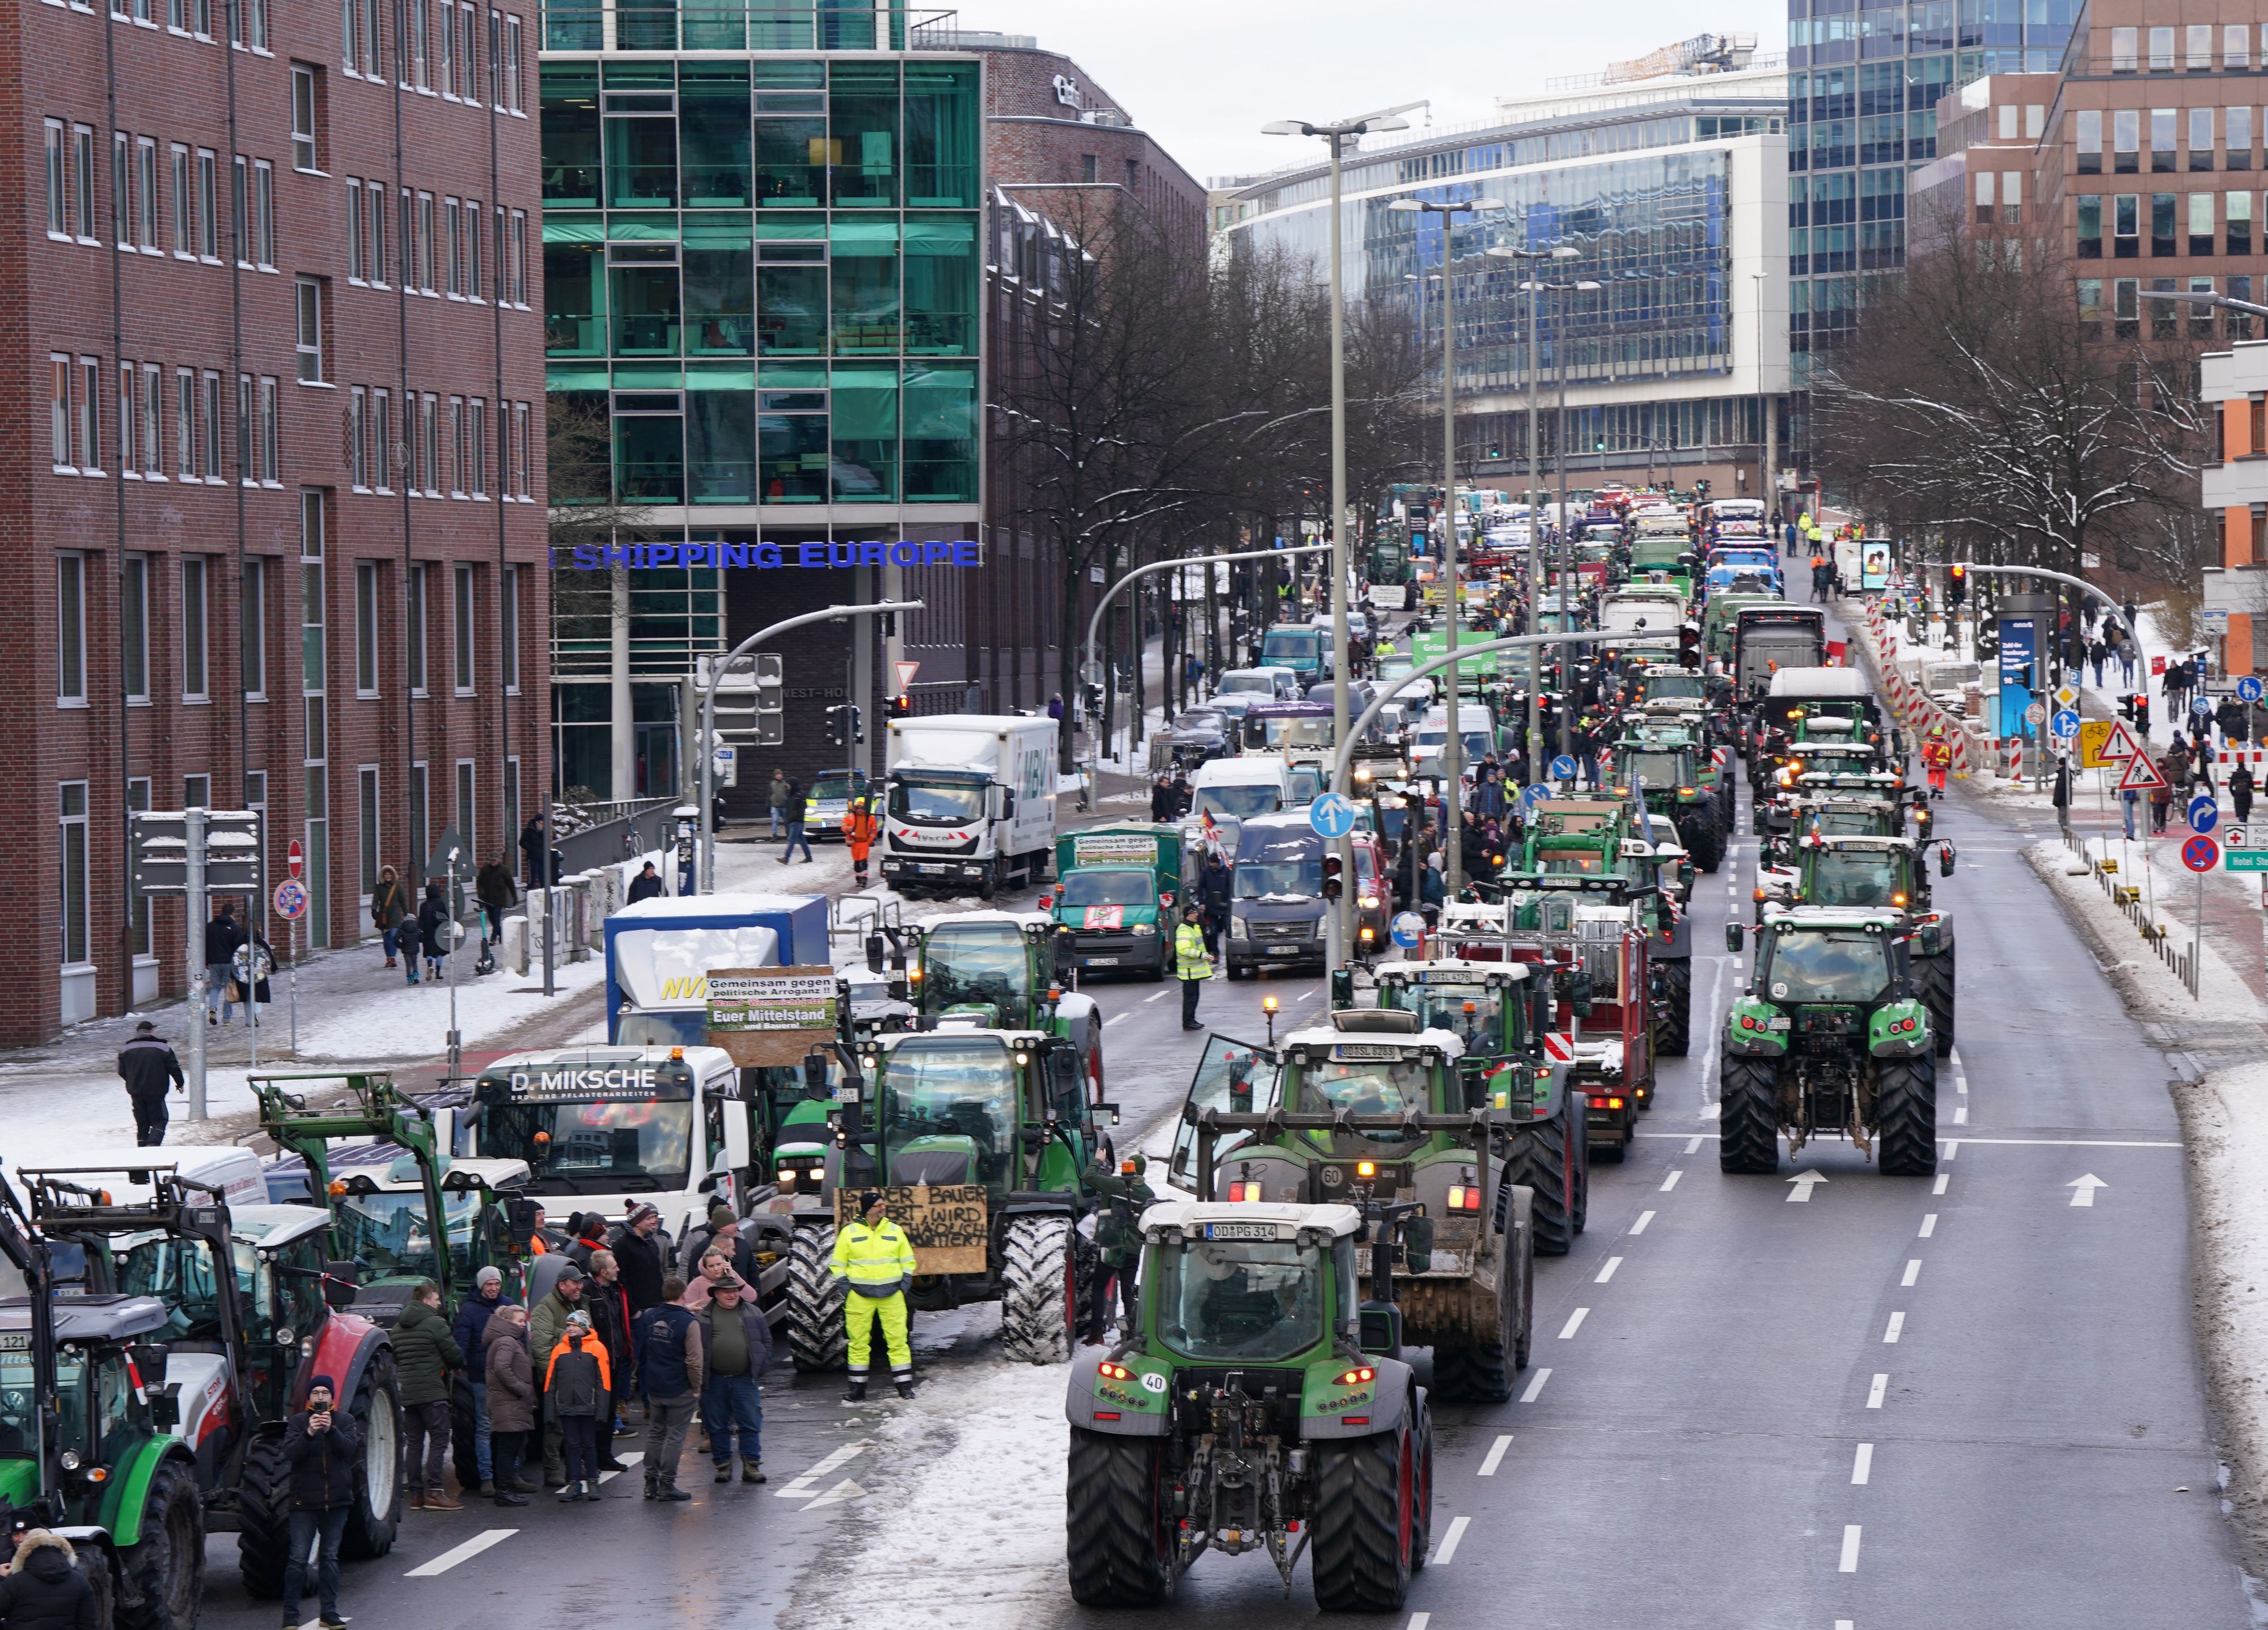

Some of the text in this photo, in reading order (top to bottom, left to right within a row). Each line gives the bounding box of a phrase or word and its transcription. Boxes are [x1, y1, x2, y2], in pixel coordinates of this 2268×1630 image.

[572, 542, 783, 570] SHIPPING
[799, 540, 978, 568] EUROPE
[2233, 857, 2253, 866] Hotel
[1515, 894, 1525, 904] 40
[710, 979, 830, 988] Gemeinsam gegen
[714, 989, 767, 997] politische
[1775, 985, 1785, 995] 40
[801, 998, 826, 1006] jetzt!
[713, 1008, 825, 1022] Euer Mittelstand
[1343, 1045, 1394, 1056] OD SL 8283
[511, 1069, 656, 1092] D. MIKSCHE
[1324, 1170, 1339, 1183] 60
[929, 1186, 987, 1205] BAUER
[931, 1206, 981, 1222] WIRD
[1214, 1226, 1275, 1237] OD PG 314
[3, 1336, 26, 1348] 121
[1146, 1375, 1162, 1389] 40
